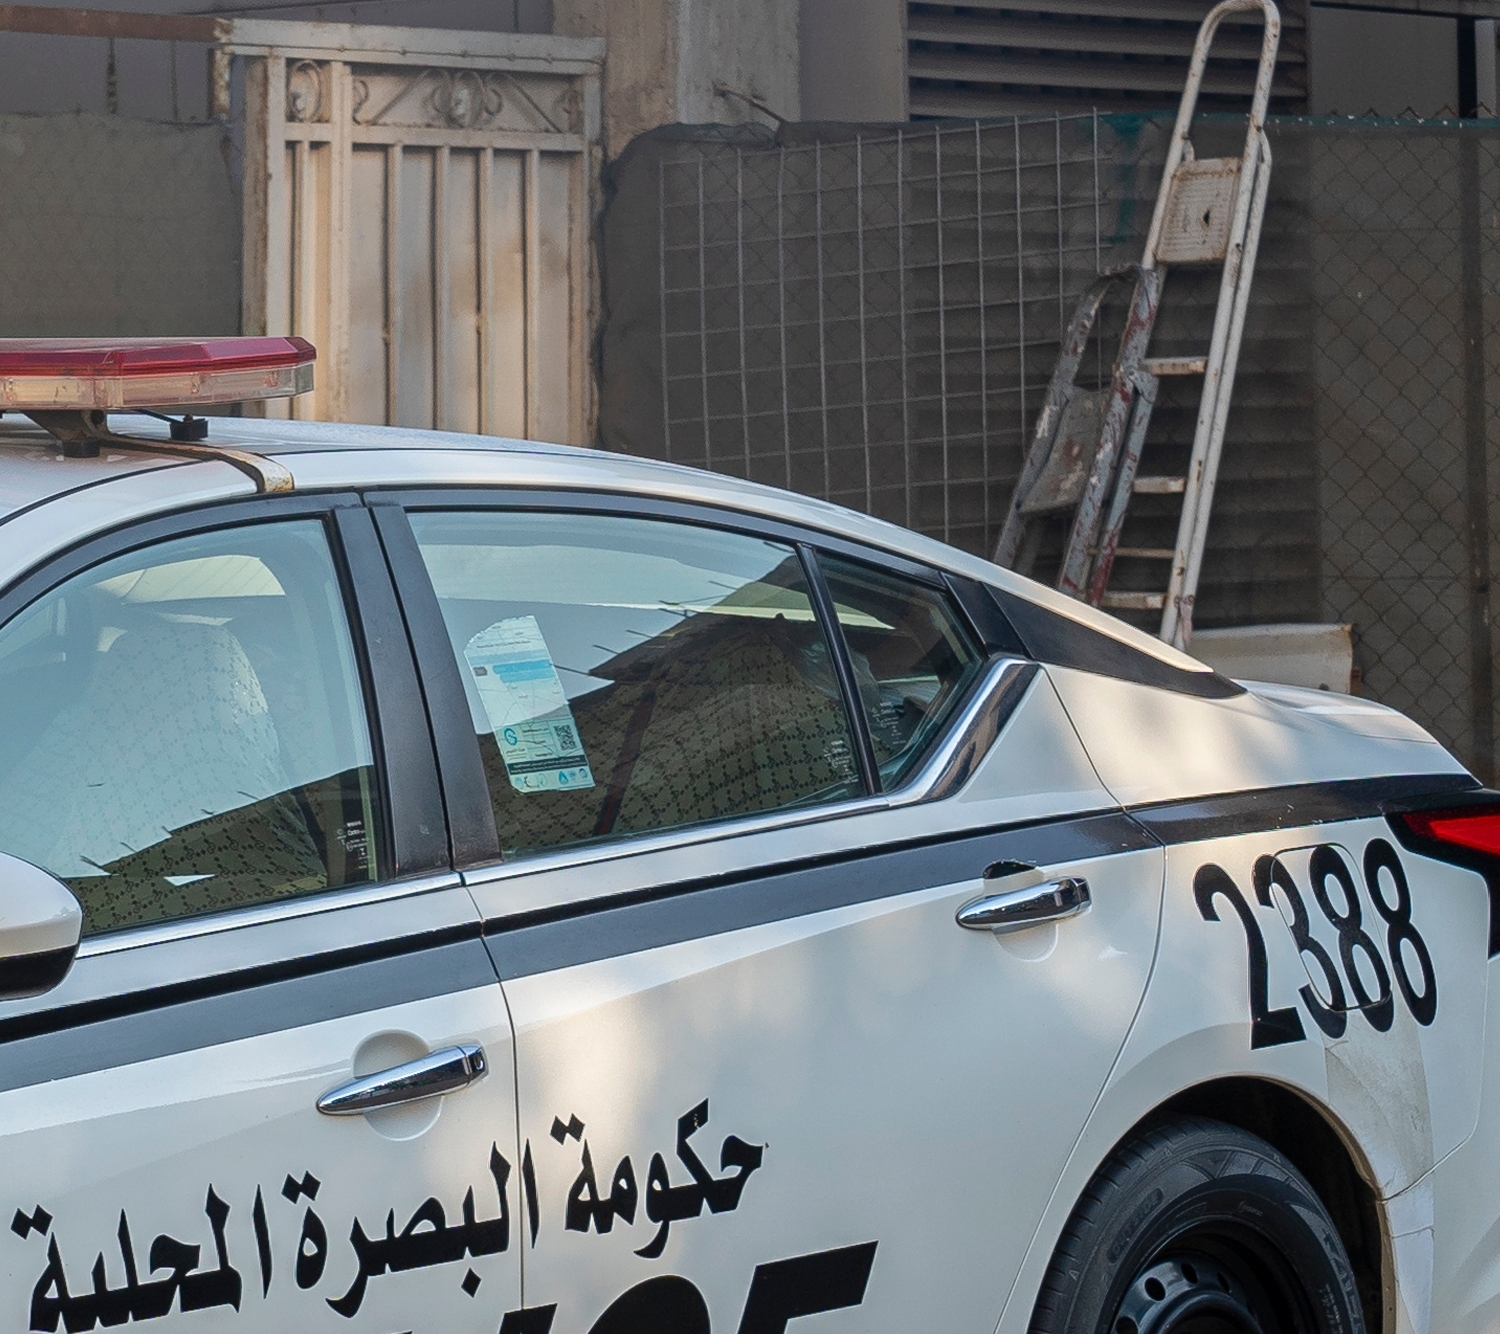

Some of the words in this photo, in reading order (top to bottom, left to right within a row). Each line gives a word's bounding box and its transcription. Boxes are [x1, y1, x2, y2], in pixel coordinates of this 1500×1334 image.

[1193, 838, 1437, 1049] 2388
[282, 1138, 541, 1318] البصرة
[550, 1098, 768, 1259] حكومة
